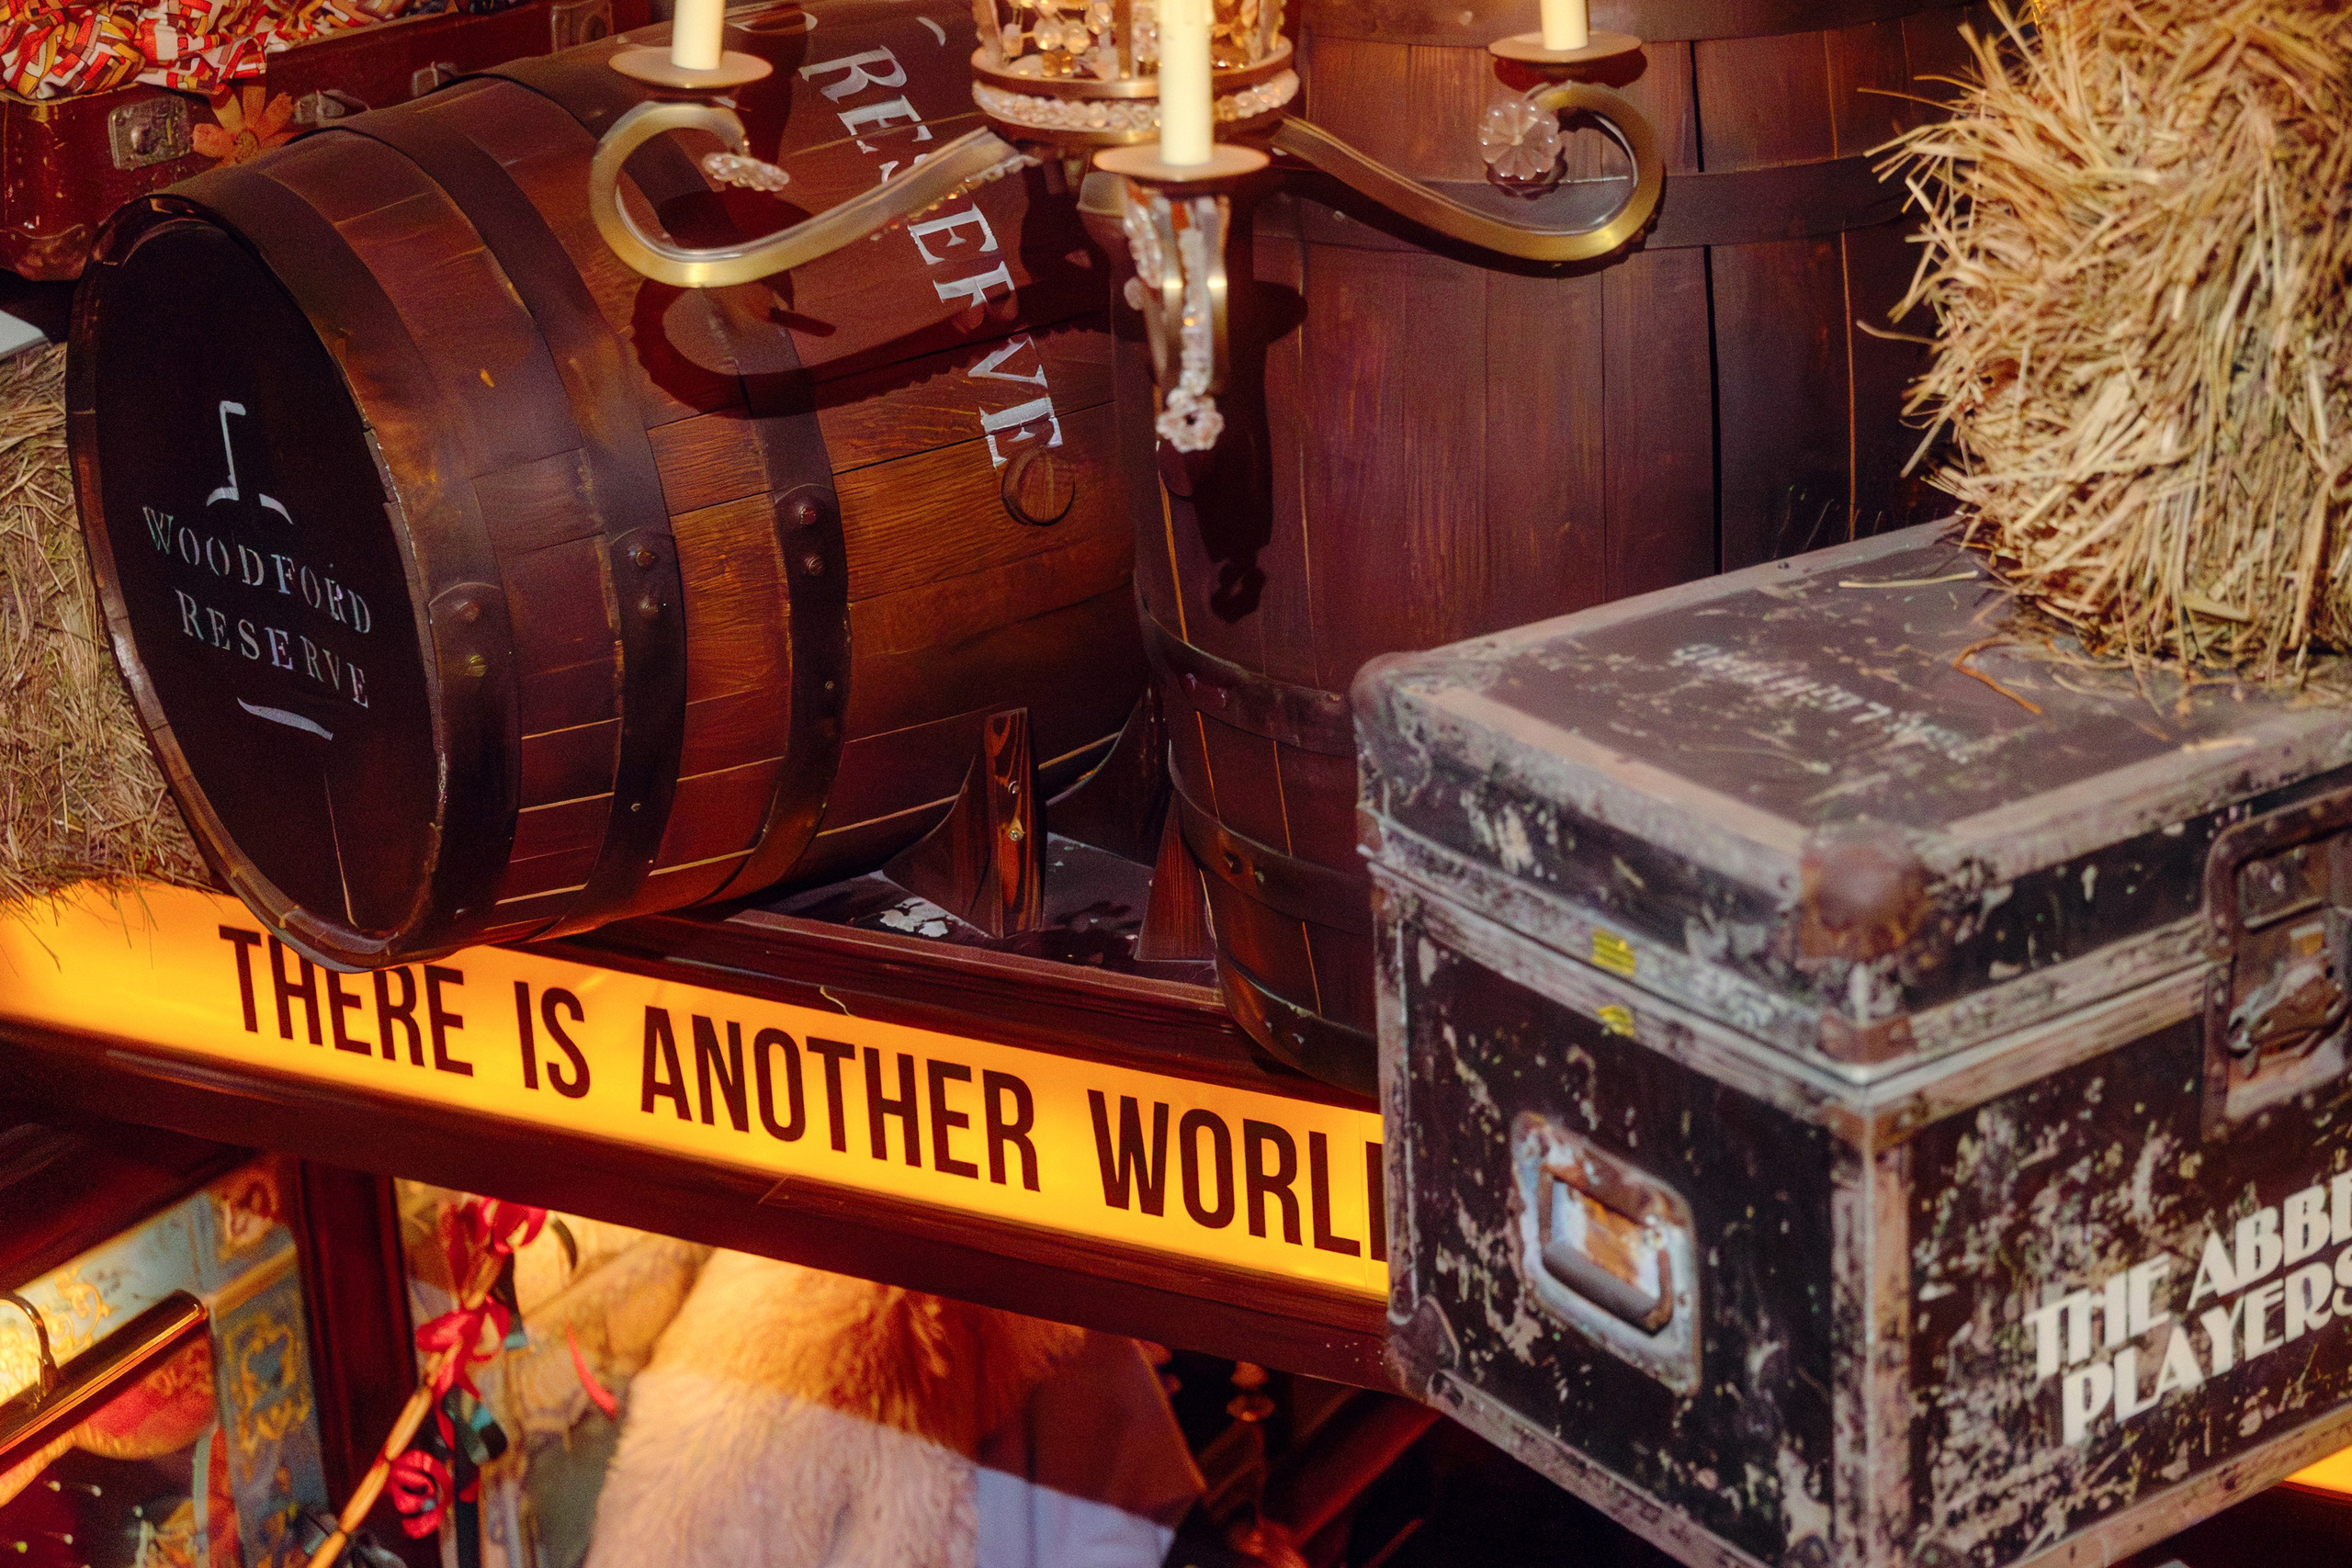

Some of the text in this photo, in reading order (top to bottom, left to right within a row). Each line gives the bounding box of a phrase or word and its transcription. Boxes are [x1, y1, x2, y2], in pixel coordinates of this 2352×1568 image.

[797, 44, 1064, 469] REERVE
[141, 505, 372, 636] WOODFORD
[174, 588, 369, 709] RESERVE
[218, 924, 473, 1077] THERE
[513, 980, 591, 1100] IS
[640, 1005, 1041, 1193] ANOTHER
[2023, 1253, 2172, 1380] THE
